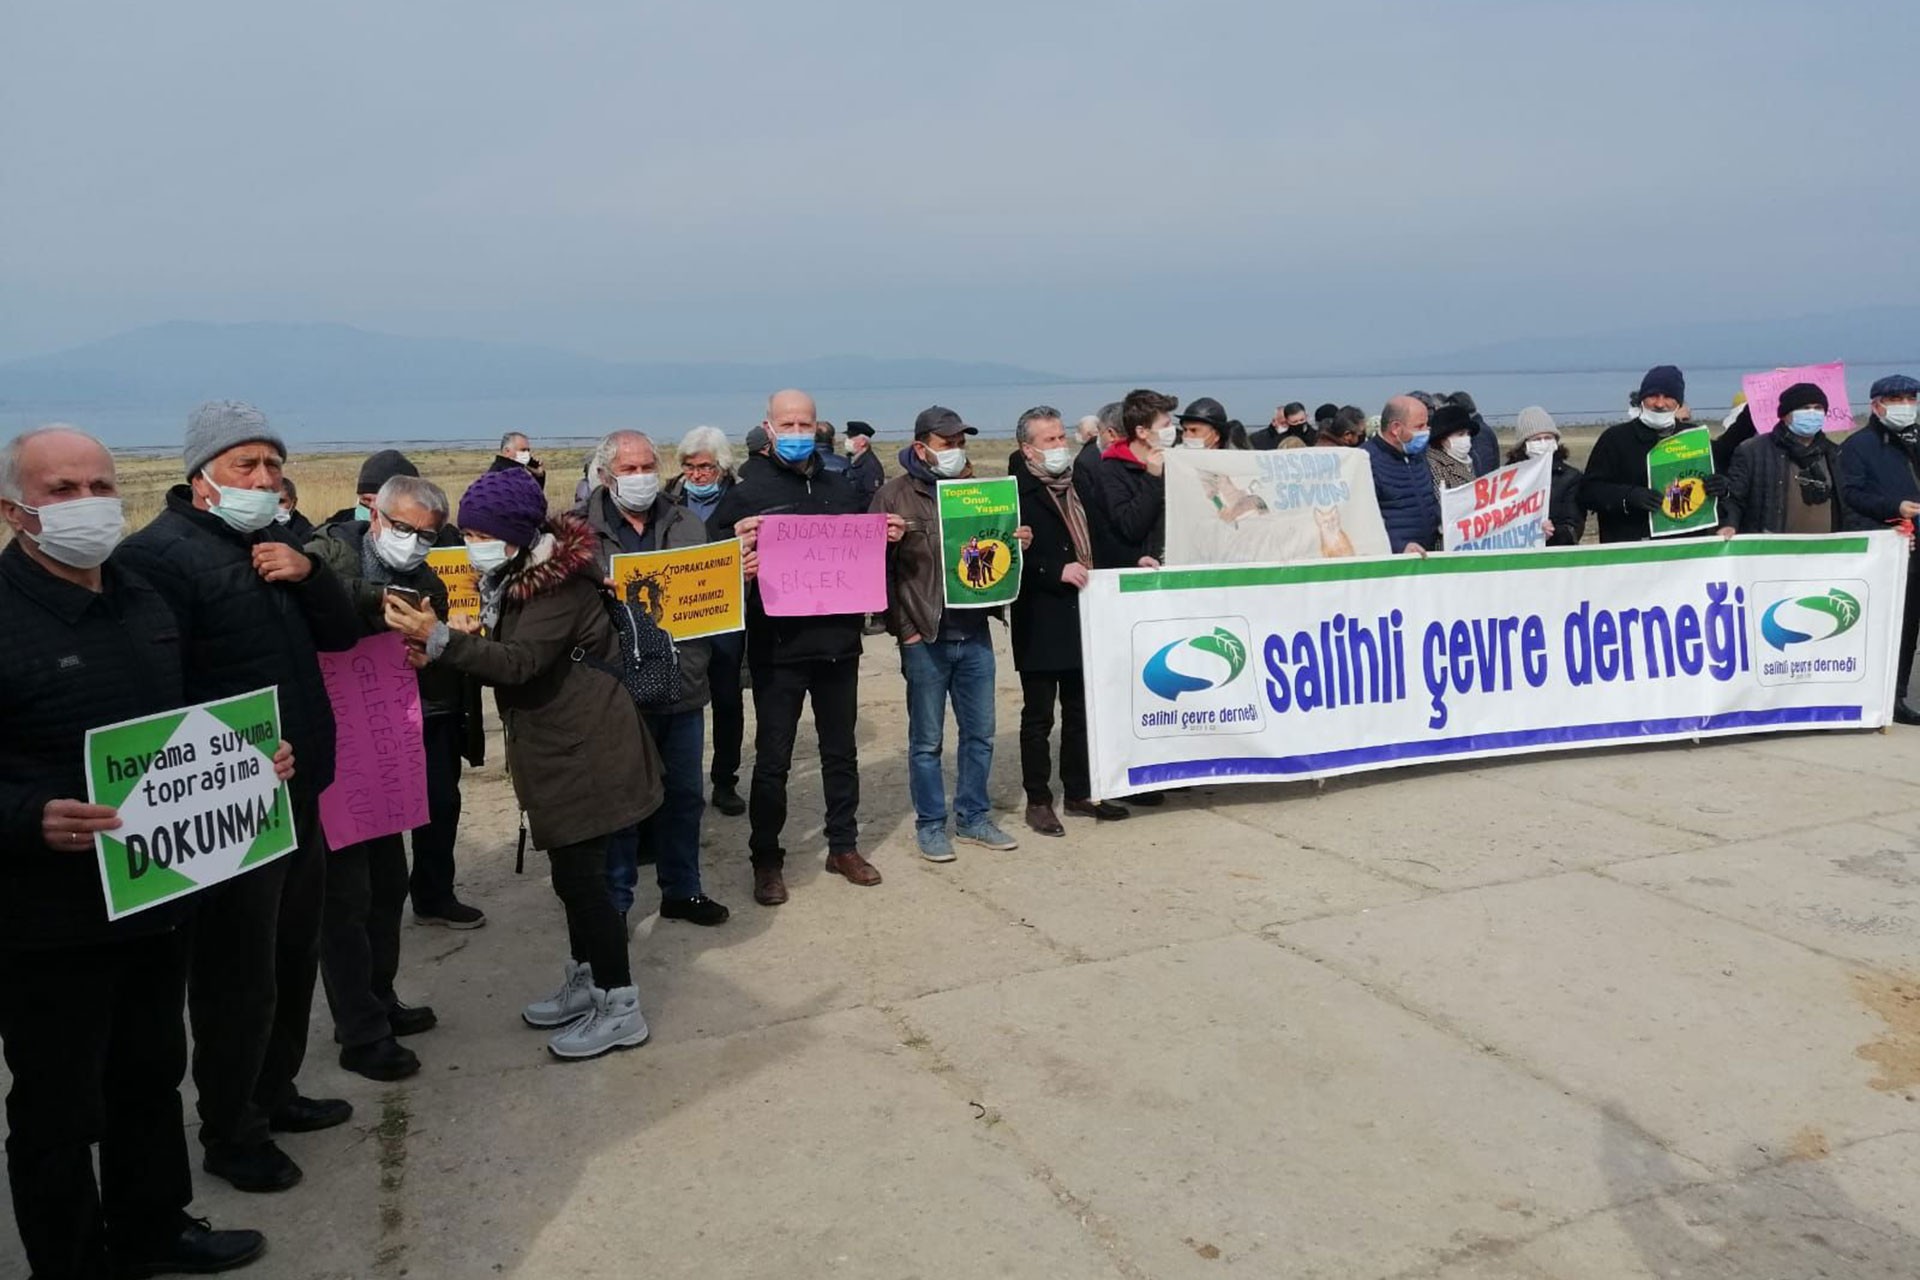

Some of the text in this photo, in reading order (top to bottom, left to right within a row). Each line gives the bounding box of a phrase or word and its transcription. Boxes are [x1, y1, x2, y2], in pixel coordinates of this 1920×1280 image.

[1274, 481, 1350, 510] SAVUN
[842, 522, 885, 541] EKEN
[803, 545, 859, 561] ALTIN
[669, 555, 733, 575] TOPRAKLARIMIZI
[449, 584, 457, 592] ve
[781, 569, 853, 596] BİÇER
[679, 589, 724, 606] YAŞAMIMIZI
[672, 603, 729, 622] SAVUNUYORUZ
[1263, 582, 1749, 730] salihli çevre derneği
[1813, 657, 1857, 673] derneği
[1141, 703, 1259, 730] salihli çevre derneği
[106, 720, 274, 783] havama suyuma
[143, 756, 260, 807] toprağıma
[125, 787, 280, 880] DOKUNMA!
